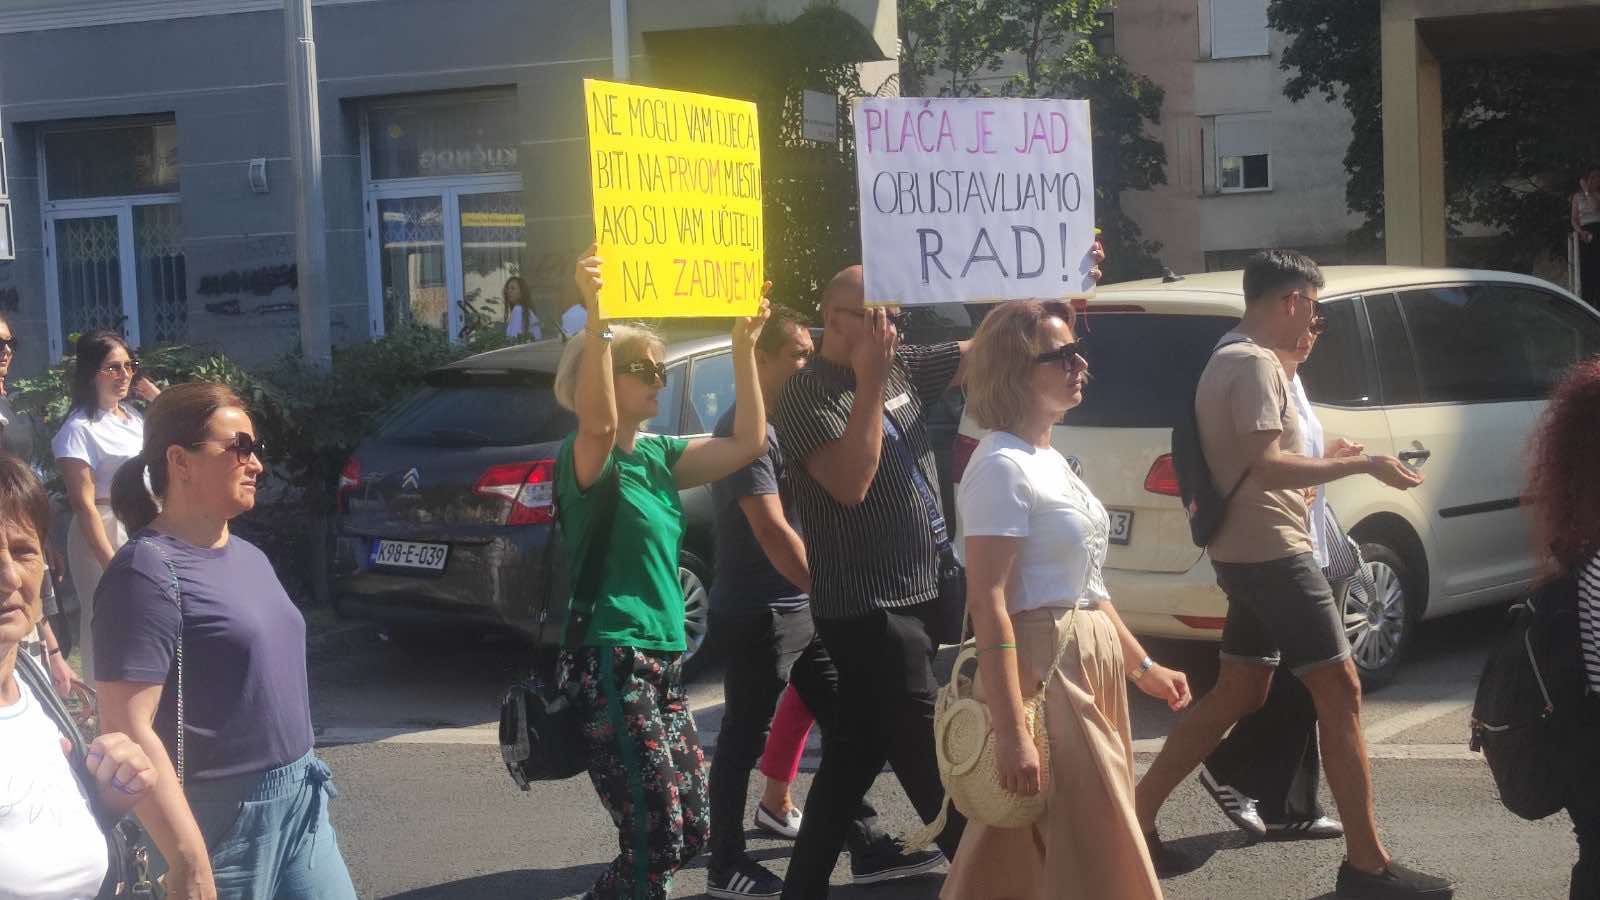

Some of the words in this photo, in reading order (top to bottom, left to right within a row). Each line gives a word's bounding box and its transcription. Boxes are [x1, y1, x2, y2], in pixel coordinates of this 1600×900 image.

[592, 92, 622, 136] NE
[628, 97, 678, 143] MOGU
[683, 103, 713, 144] VAM
[864, 101, 955, 153] PLAĆA
[966, 112, 997, 154] JE
[1014, 111, 1069, 154] JAD
[597, 150, 631, 190] BITI
[637, 153, 666, 193] NA
[667, 155, 722, 194] PRVOM
[723, 160, 761, 201] MJESTU
[872, 170, 1081, 214] OBUSTAVLJAMO
[600, 204, 639, 246] AKO
[643, 204, 667, 245] SU
[672, 207, 705, 245] VAM
[711, 204, 760, 252] UČITELJI
[622, 260, 658, 303] NA
[378, 543, 444, 566] K98-E-039
